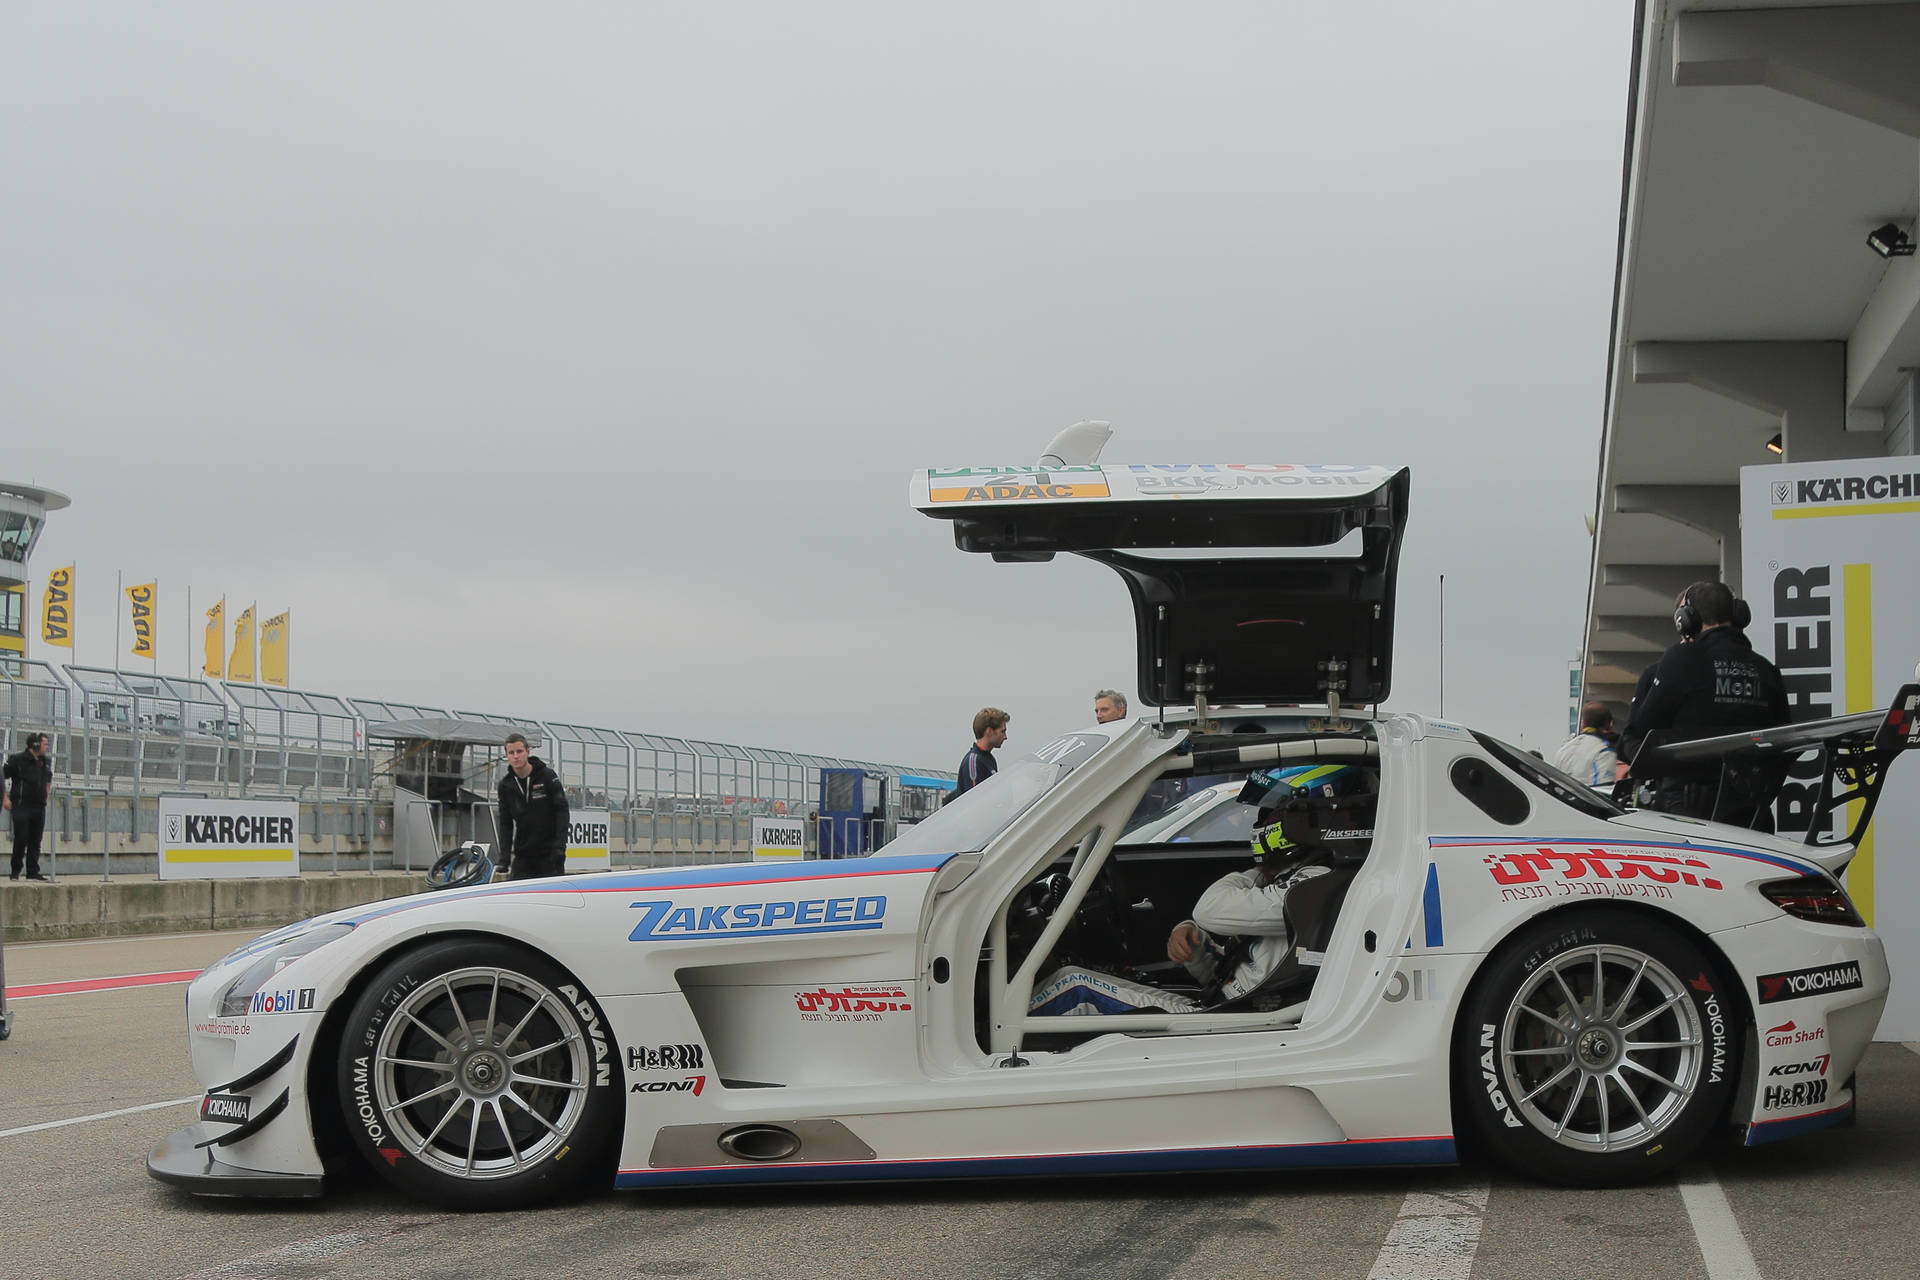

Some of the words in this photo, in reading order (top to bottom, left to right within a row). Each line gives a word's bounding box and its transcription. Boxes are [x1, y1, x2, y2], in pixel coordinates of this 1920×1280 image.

[964, 484, 1074, 501] ADAC
[1136, 476, 1218, 488] BKK
[1236, 475, 1370, 486] MOBIL
[185, 815, 294, 844] KÄRCHER
[567, 823, 608, 844] RCHER
[762, 828, 802, 846] KÄRCHER
[1321, 829, 1374, 840] ZAKSPEE
[628, 896, 887, 941] ZAKSPEED
[1787, 966, 1860, 993] YOKOHAMA
[253, 989, 296, 1013] Mobil
[302, 989, 312, 1008] 1
[558, 984, 610, 1087] ADVAN
[1704, 994, 1726, 1083] YOKOHAMA
[1766, 1035, 1794, 1047] Cam
[1795, 1027, 1825, 1043] Shaft
[627, 1045, 681, 1071] H&R
[1768, 1060, 1821, 1076] KONI
[630, 1078, 696, 1094] KONI
[1480, 1023, 1524, 1128] ADVAN
[354, 1056, 387, 1146] YOKOHAMA
[1763, 1082, 1809, 1110] H&R
[207, 1099, 248, 1118] YOKOHAMA
